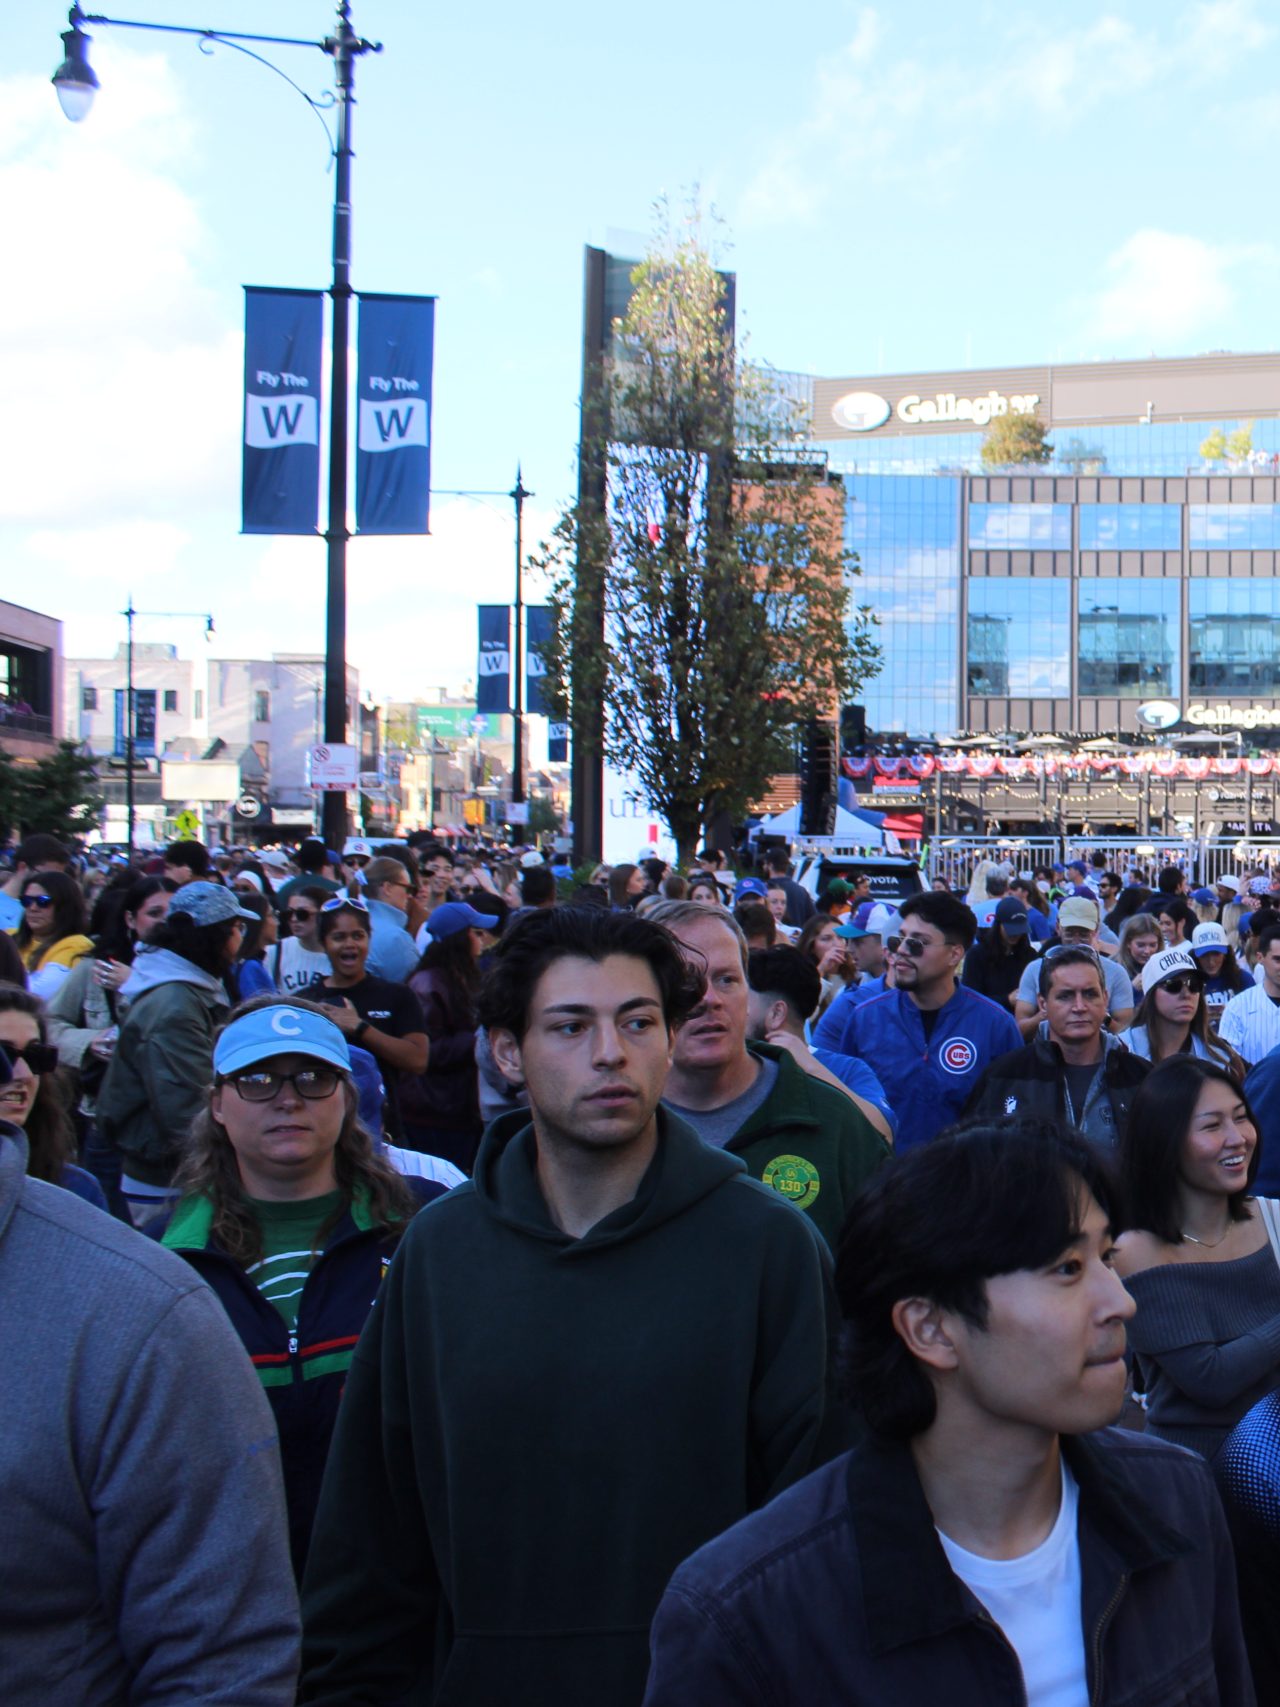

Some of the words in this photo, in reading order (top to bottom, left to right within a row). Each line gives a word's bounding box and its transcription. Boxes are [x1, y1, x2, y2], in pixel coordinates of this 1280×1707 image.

[256, 370, 280, 388] Fly
[281, 372, 309, 387] The
[369, 376, 392, 392] Fly
[392, 377, 419, 391] The
[262, 403, 303, 439] W
[374, 406, 414, 443] W
[485, 655, 503, 671] W
[284, 971, 322, 990] CUB
[271, 1008, 303, 1037] C
[780, 1180, 801, 1192] 130
